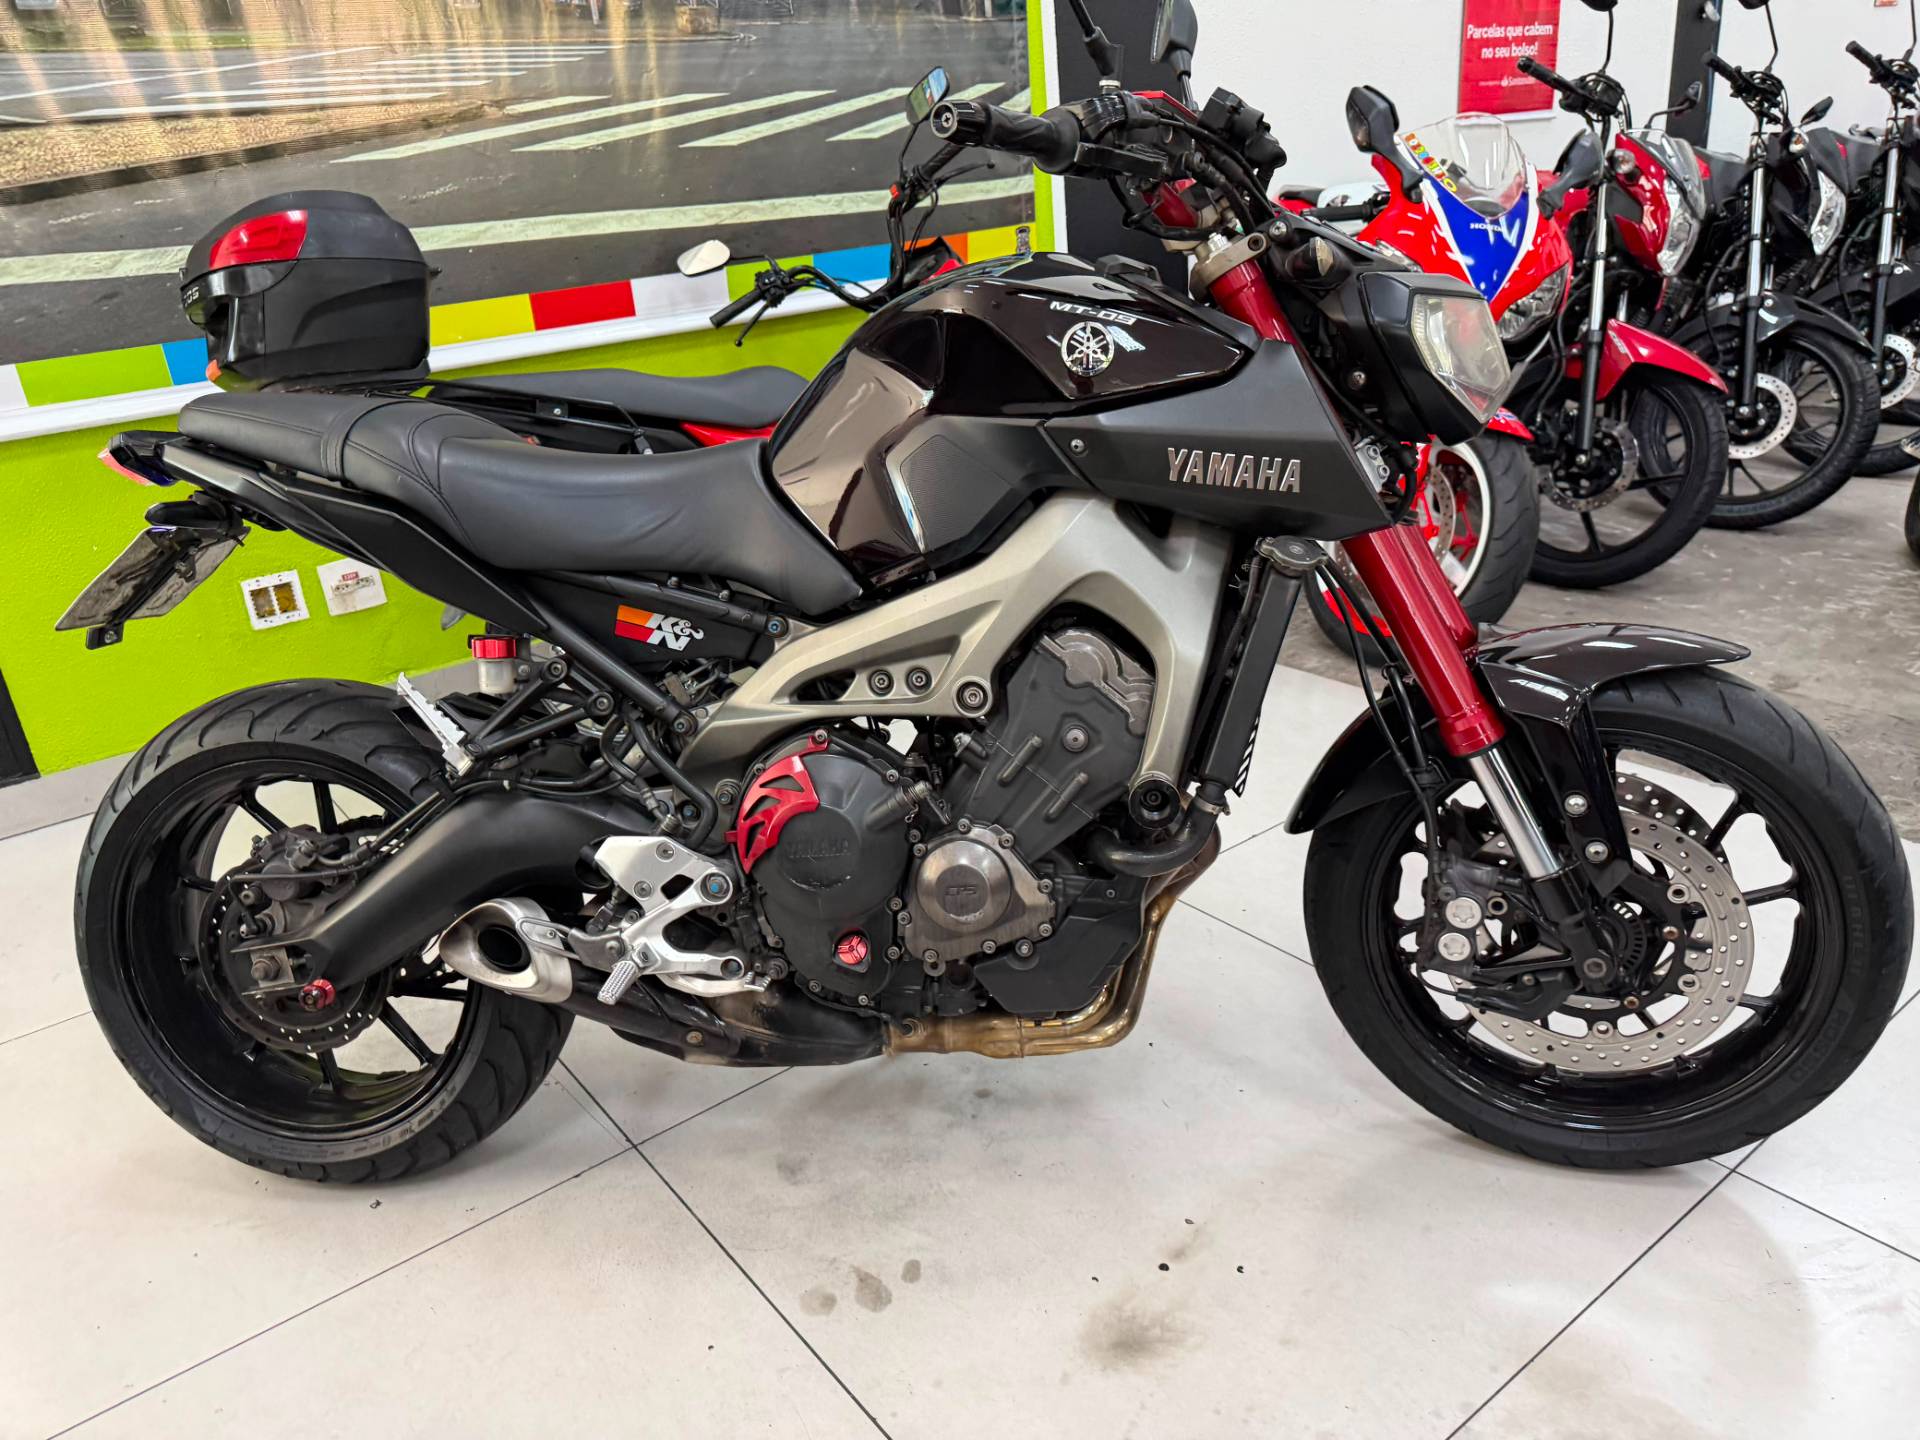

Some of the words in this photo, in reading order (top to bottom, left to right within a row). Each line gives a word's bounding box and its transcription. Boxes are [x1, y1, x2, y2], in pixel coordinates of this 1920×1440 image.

[1467, 23, 1505, 39] Parcelas
[1506, 26, 1523, 40] que
[1524, 21, 1553, 36] cabem
[1481, 48, 1493, 59] no
[1495, 46, 1510, 58] seu
[1511, 41, 1538, 57] bolso!
[1049, 301, 1138, 326] MT-09
[1167, 447, 1302, 493] YAMAHA
[645, 612, 704, 652] K&N
